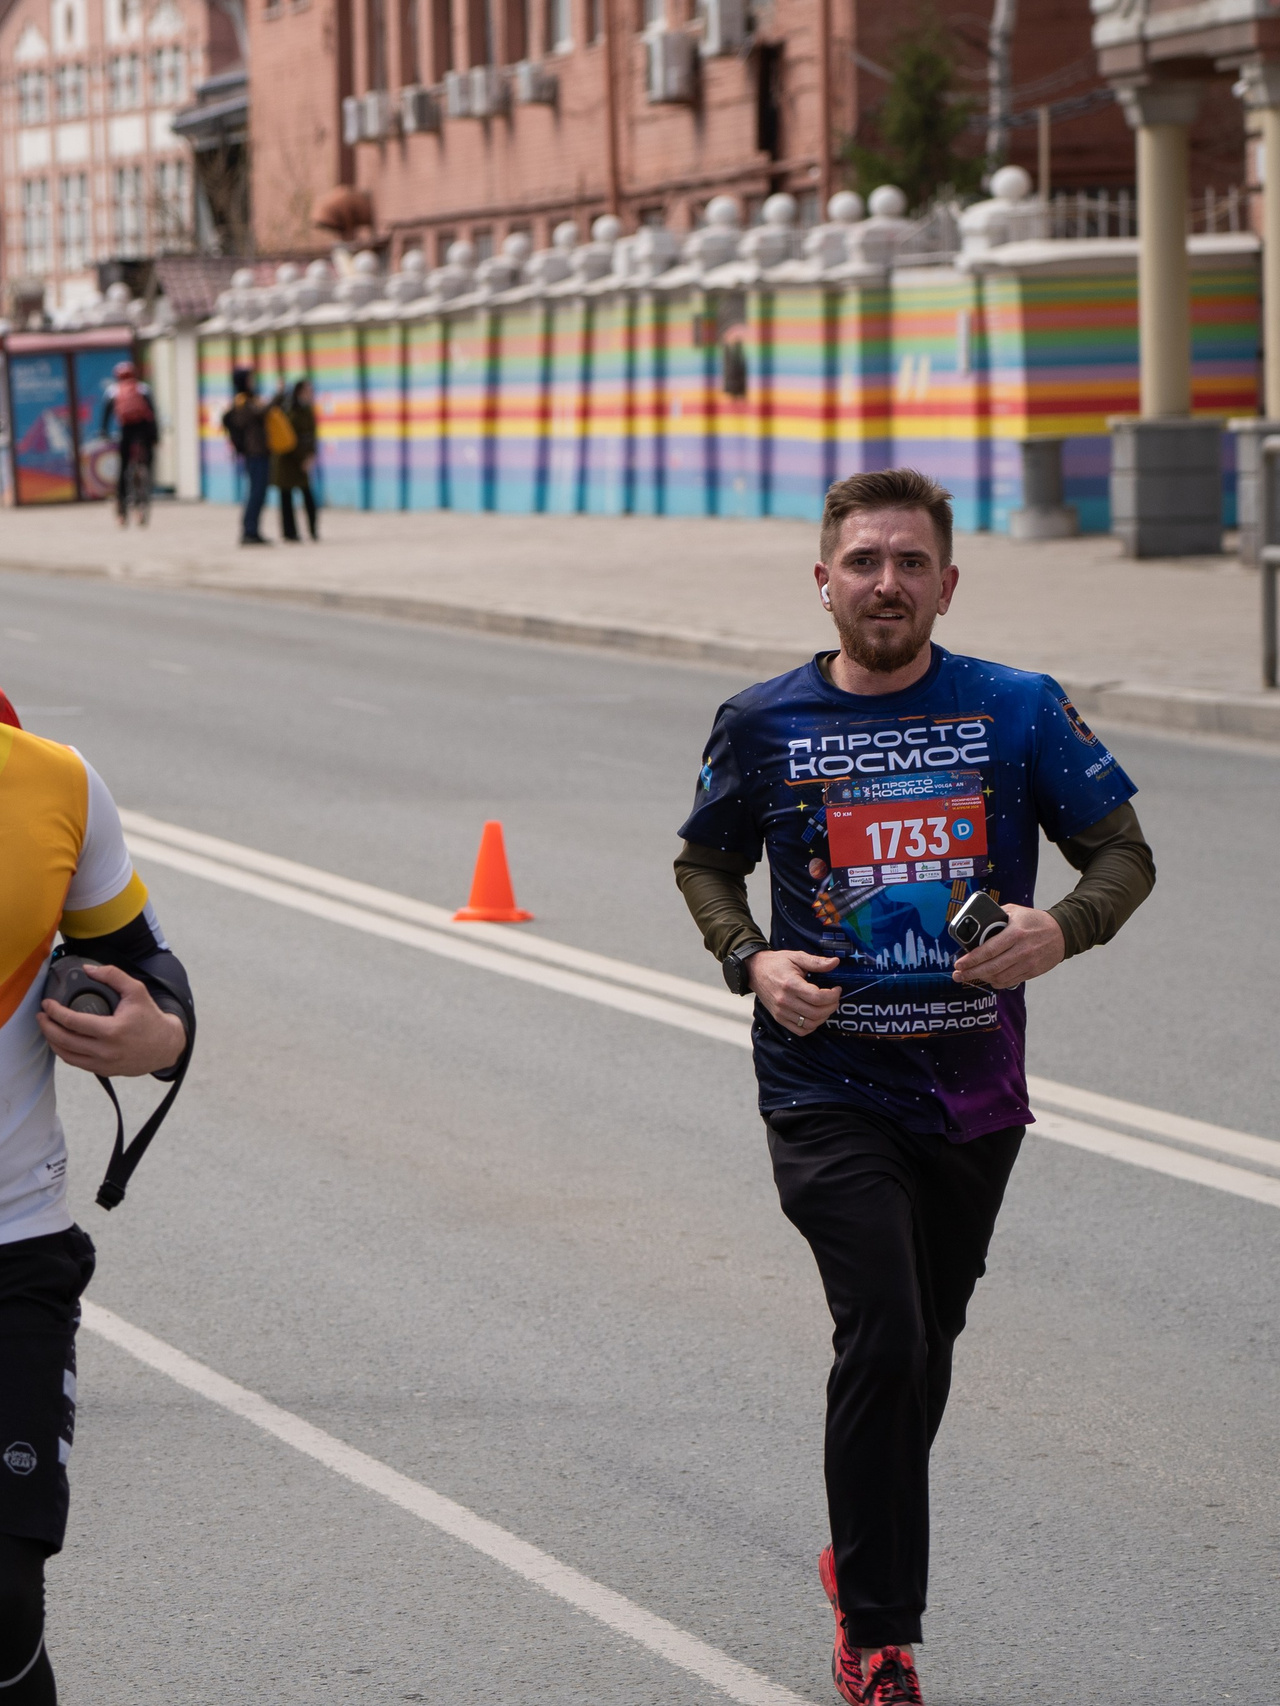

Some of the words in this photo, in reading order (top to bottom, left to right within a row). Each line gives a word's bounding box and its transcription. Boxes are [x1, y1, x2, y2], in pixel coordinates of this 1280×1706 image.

[788, 737, 812, 756] Я
[821, 722, 986, 752] ПРОСТО
[789, 741, 990, 779] КОСМОС
[871, 785, 934, 798] КОСМОС
[882, 778, 934, 789] ПРОСТО
[866, 816, 950, 860] 1733
[956, 823, 970, 836] D
